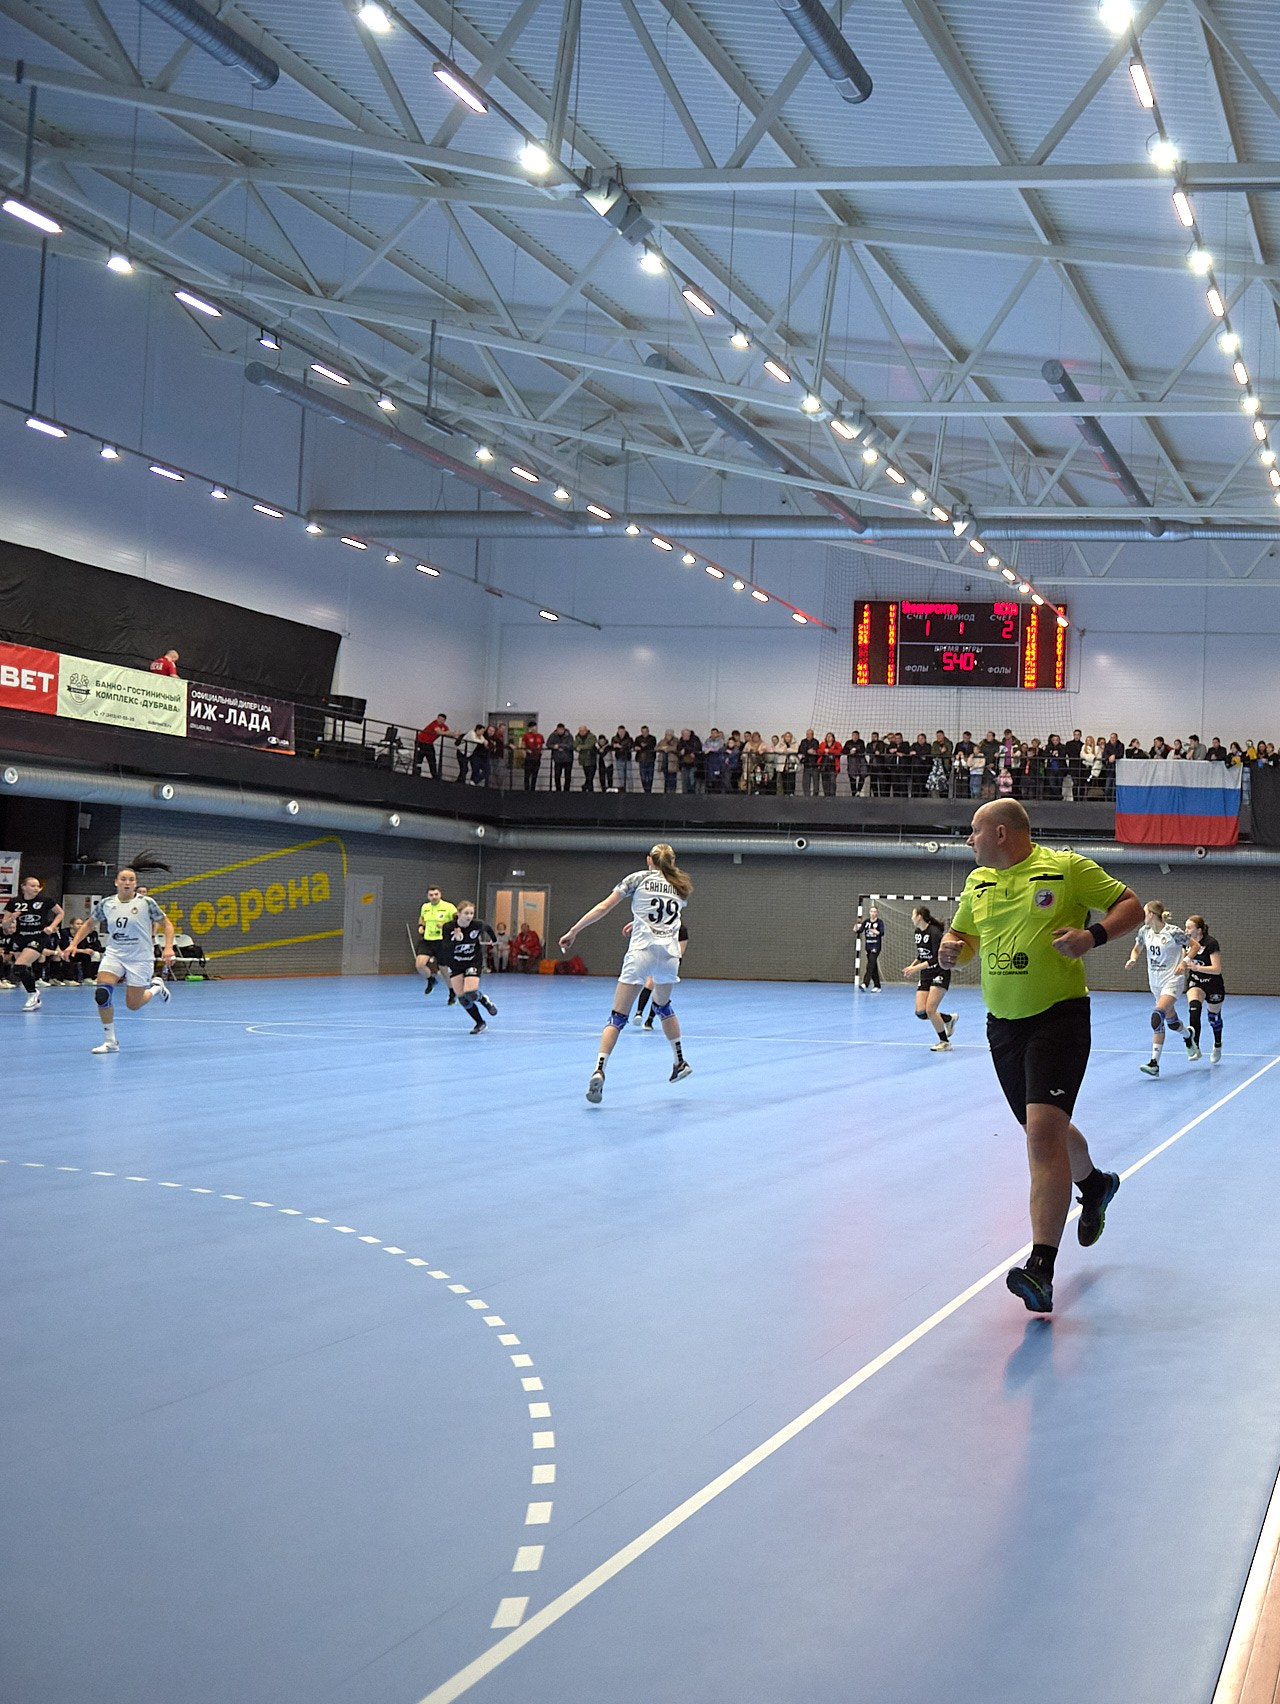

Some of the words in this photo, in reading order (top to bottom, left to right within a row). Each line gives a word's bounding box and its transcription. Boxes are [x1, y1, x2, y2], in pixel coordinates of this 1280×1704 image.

[944, 613, 975, 621] ПЕРИОД
[925, 620, 931, 637] 1
[959, 621, 965, 635] 1
[1001, 620, 1014, 639] 2
[905, 665, 929, 673] ФОЛЫ
[987, 666, 1012, 674] ФОЛЫ
[95, 691, 139, 706] КОМПЛЕКС
[191, 690, 239, 708] ОФИЦИАЛЬНЫЙ
[238, 700, 258, 711] ДИЛЕР
[190, 700, 271, 733] ИЖ-ЛАДА
[14, 902, 29, 912] 22
[648, 897, 679, 925] 39
[116, 917, 128, 929] 67
[1149, 945, 1161, 956] 93
